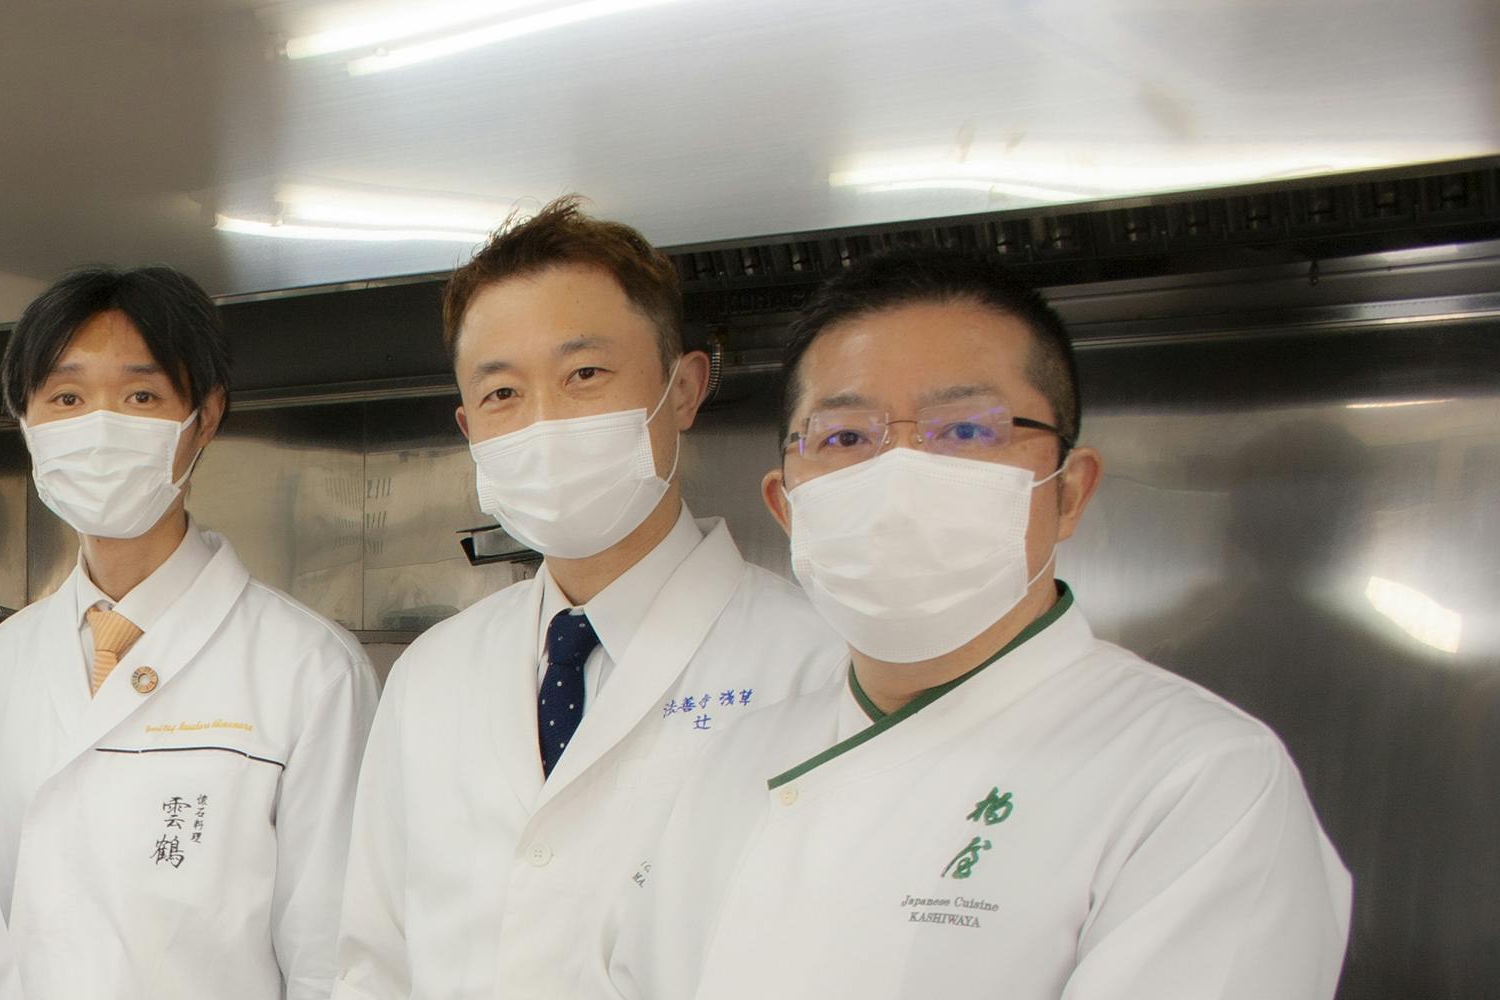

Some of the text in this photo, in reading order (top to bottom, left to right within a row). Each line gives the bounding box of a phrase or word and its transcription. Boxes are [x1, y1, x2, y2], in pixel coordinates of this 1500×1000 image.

[901, 894, 999, 912] Japanese Cuisine
[908, 911, 980, 928] KASHIWAYA
